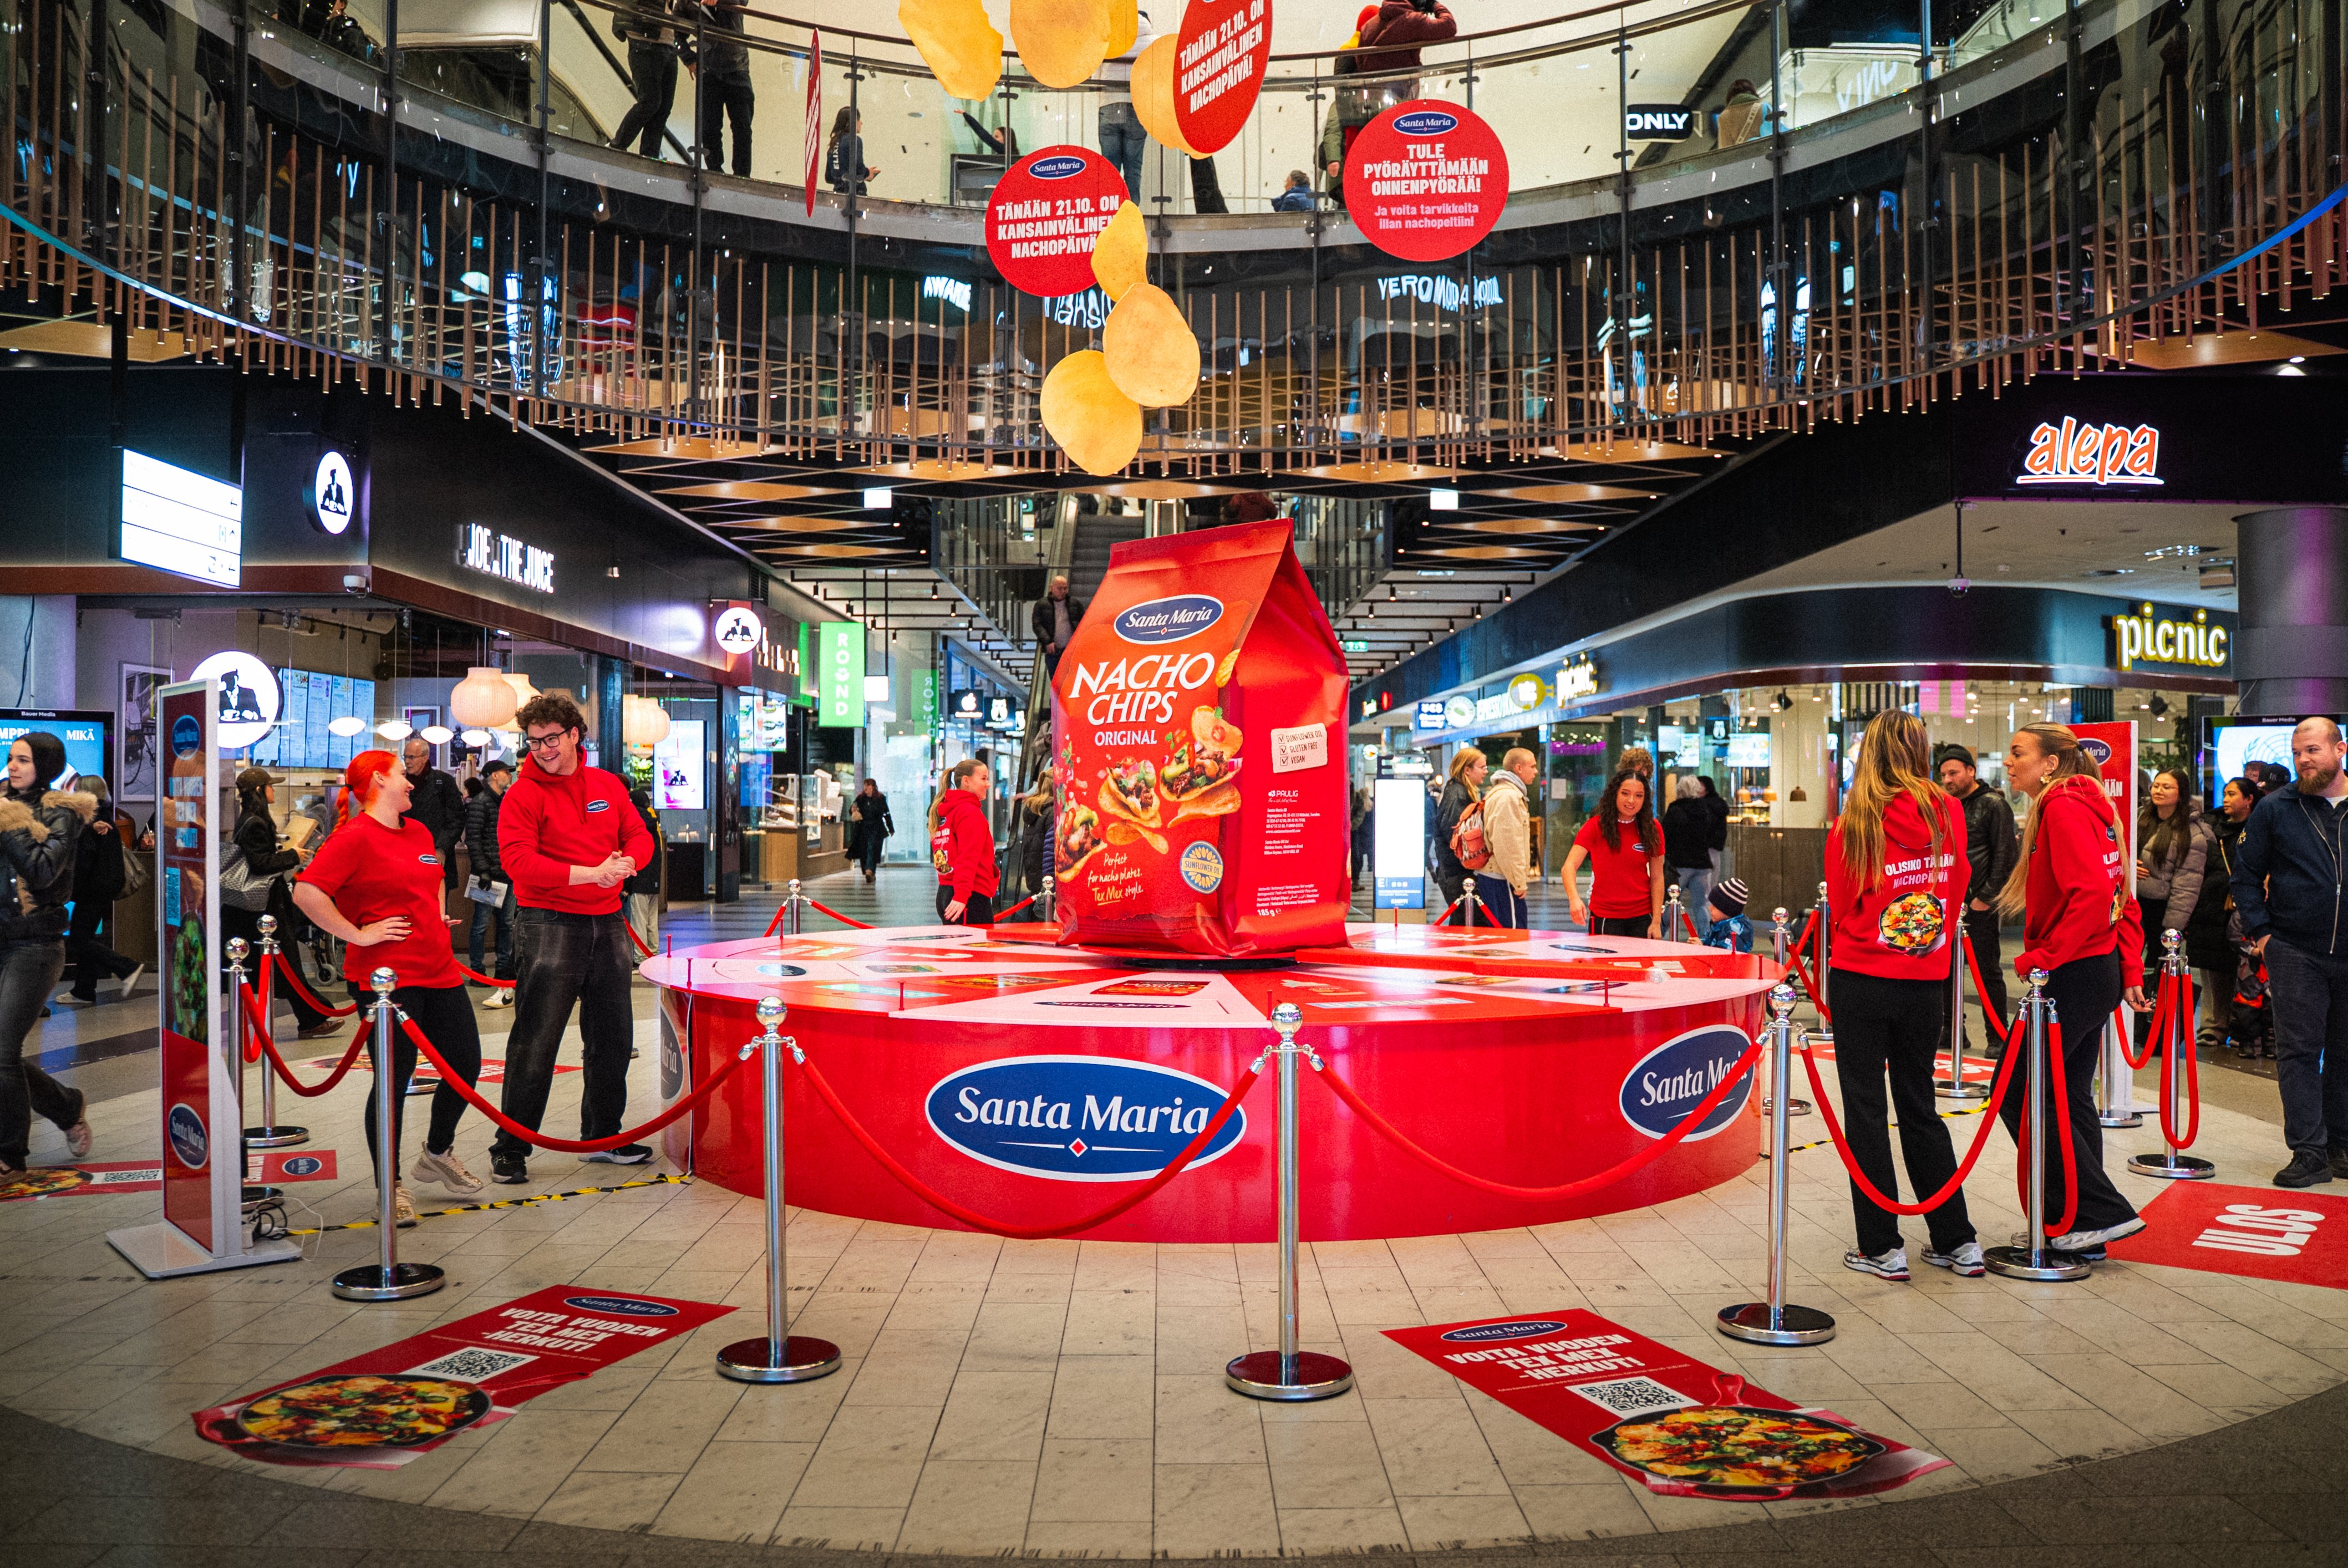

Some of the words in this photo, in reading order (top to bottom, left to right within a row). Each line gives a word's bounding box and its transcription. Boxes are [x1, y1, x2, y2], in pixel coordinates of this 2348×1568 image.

[1180, 28, 1217, 70] TÄNÄÄN
[1220, 10, 1247, 44] 21.10.
[1250, 0, 1264, 21] ON
[1181, 22, 1262, 95] KANSAINVÄLINEN
[1190, 54, 1252, 114] NACHOPÄIVÄ!
[1399, 119, 1425, 127] Santa
[1425, 118, 1451, 126] Maria
[1626, 113, 1689, 130] ONLY
[1406, 144, 1445, 159] TULE
[1034, 164, 1056, 172] Santa
[1057, 162, 1080, 170] Maria
[1364, 157, 1488, 179] PYÖRÄYTTÄMÄÄN
[1371, 176, 1481, 196] ONNENPYÖRÄÄ!
[996, 200, 1050, 221] TÄNÄÄN
[1055, 198, 1095, 215] 21.10.
[1100, 195, 1119, 211] ON
[1374, 206, 1388, 216] Ja
[1391, 205, 1417, 215] voita
[1420, 202, 1479, 215] tarvikkeita
[1379, 218, 1402, 229] illan
[1405, 216, 1474, 229] nachopeltiin!
[2024, 416, 2159, 485] alepa
[467, 523, 491, 572] JOE
[500, 534, 523, 583] THE
[524, 545, 554, 594] JUICE
[1125, 612, 1169, 627] Santa
[1169, 607, 1213, 624] Maria
[2113, 602, 2227, 670] picnic
[1068, 653, 1215, 698] NACHO
[1087, 691, 1178, 726] CHIPS
[66, 729, 95, 741] MIKÄ
[1095, 730, 1157, 746] ORIGINAL
[1286, 731, 1314, 742] SUNFLOWER
[1289, 744, 1307, 753] GLUTEN
[1308, 741, 1318, 750] FREE
[1291, 755, 1305, 764] VEGAN
[1104, 852, 1127, 869] Perfect
[1185, 861, 1213, 872] SUNFLOWER
[1885, 859, 1921, 876] OLISIKO
[1087, 870, 1099, 887] for
[1099, 869, 1119, 882] nacho
[1119, 867, 1142, 884] plates.
[1092, 887, 1106, 902] Tex
[1106, 885, 1124, 901] Mex
[1125, 882, 1143, 900] style.
[1640, 1068, 1704, 1106] Santa
[955, 1087, 1071, 1129] Santa
[1081, 1094, 1209, 1134] Maria
[171, 1116, 187, 1140] Santa
[187, 1123, 205, 1151] Maria
[2192, 1204, 2325, 1256] ULOS
[577, 1297, 619, 1308] Santa
[621, 1303, 667, 1315] Maria
[500, 1308, 569, 1323] VOITA
[568, 1317, 668, 1337] VUODEN
[505, 1321, 559, 1335] TEX
[557, 1327, 616, 1342] MEX
[1453, 1327, 1501, 1340] Santa
[1503, 1322, 1554, 1335] Maria
[482, 1331, 596, 1352] -HERKUT!
[1444, 1346, 1525, 1365] VOITA
[1522, 1334, 1632, 1353] VUODEN
[1497, 1356, 1555, 1371] TEX
[1557, 1347, 1621, 1363] MEX
[1518, 1356, 1645, 1380] -HERKUT!
